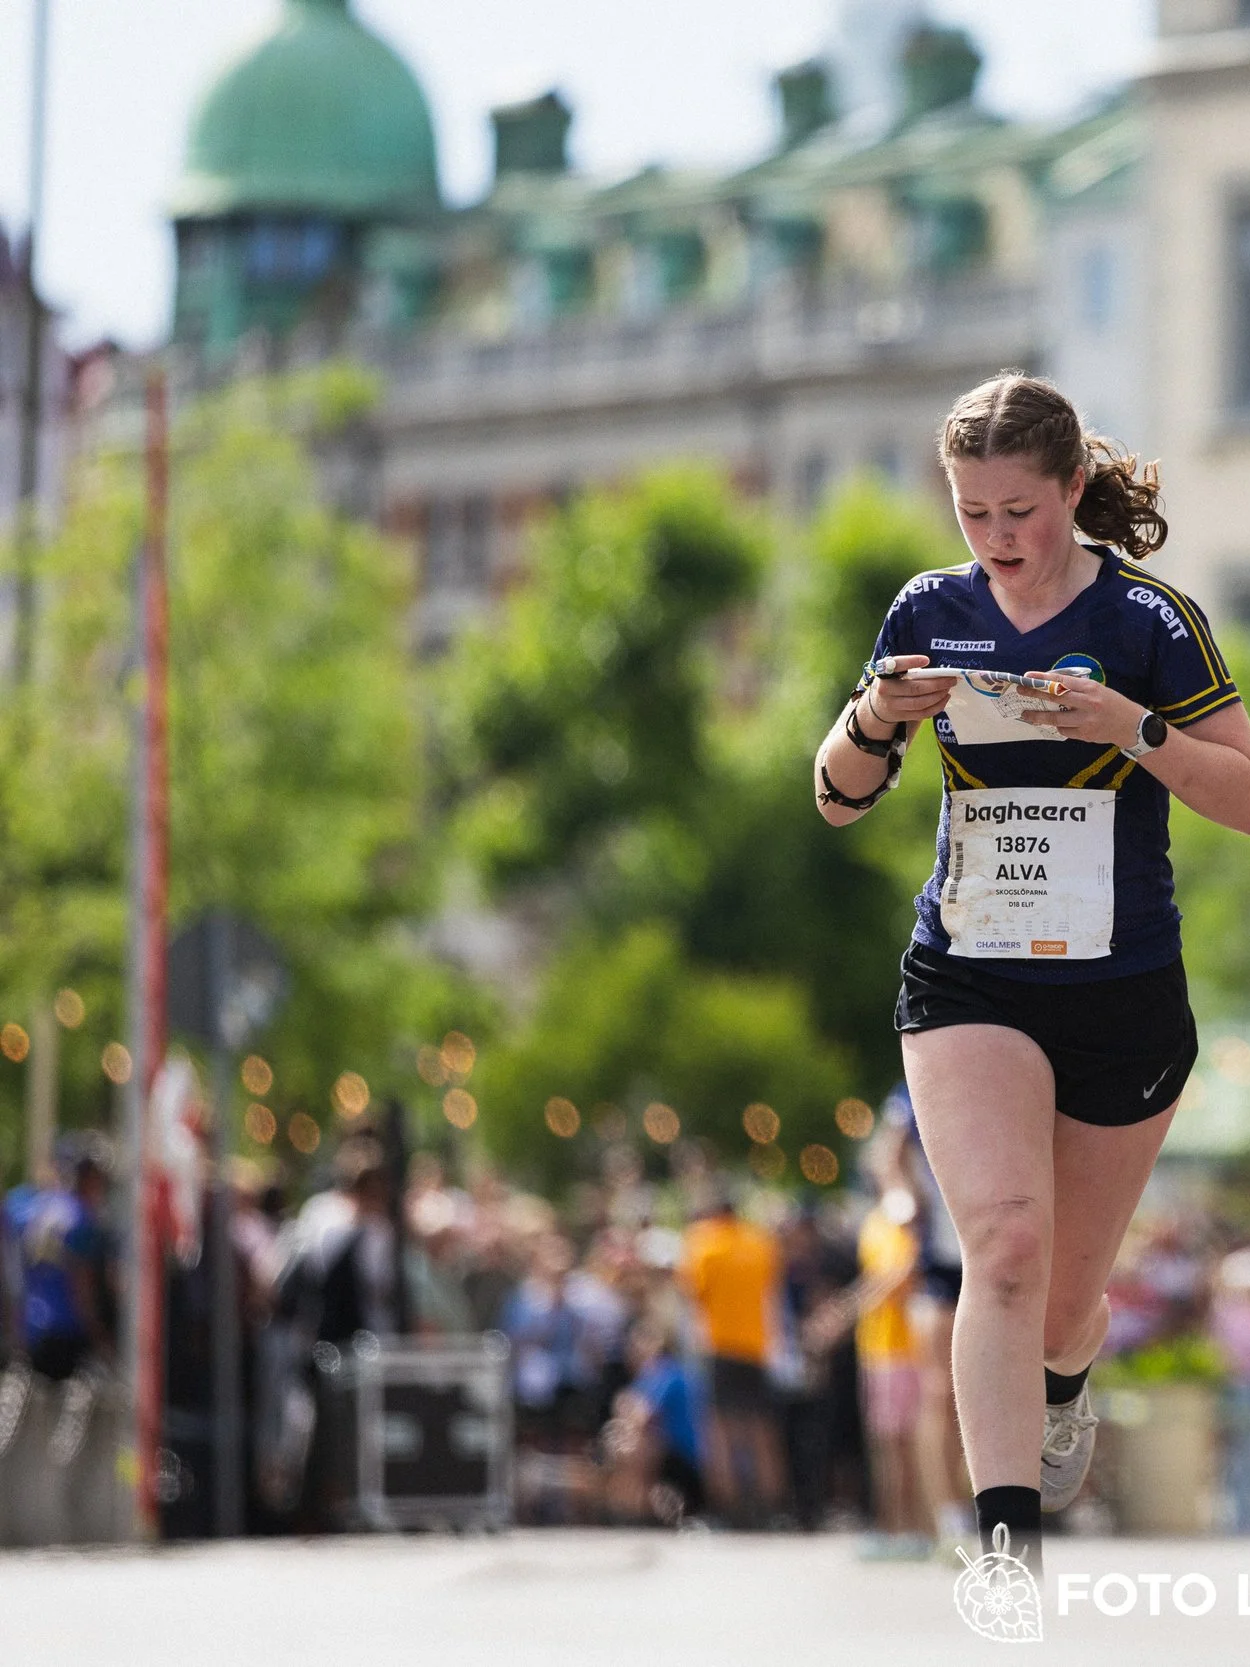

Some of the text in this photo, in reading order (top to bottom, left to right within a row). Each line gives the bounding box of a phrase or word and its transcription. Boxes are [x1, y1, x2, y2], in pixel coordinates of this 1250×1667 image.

[887, 577, 944, 620] oreIT
[1126, 586, 1189, 640] coreIT
[954, 642, 992, 650] SYSTEMS
[965, 801, 1086, 824] bagheera
[995, 836, 1050, 853] 13876
[995, 864, 1048, 880] ALVA
[976, 941, 1021, 949] CHALMERS
